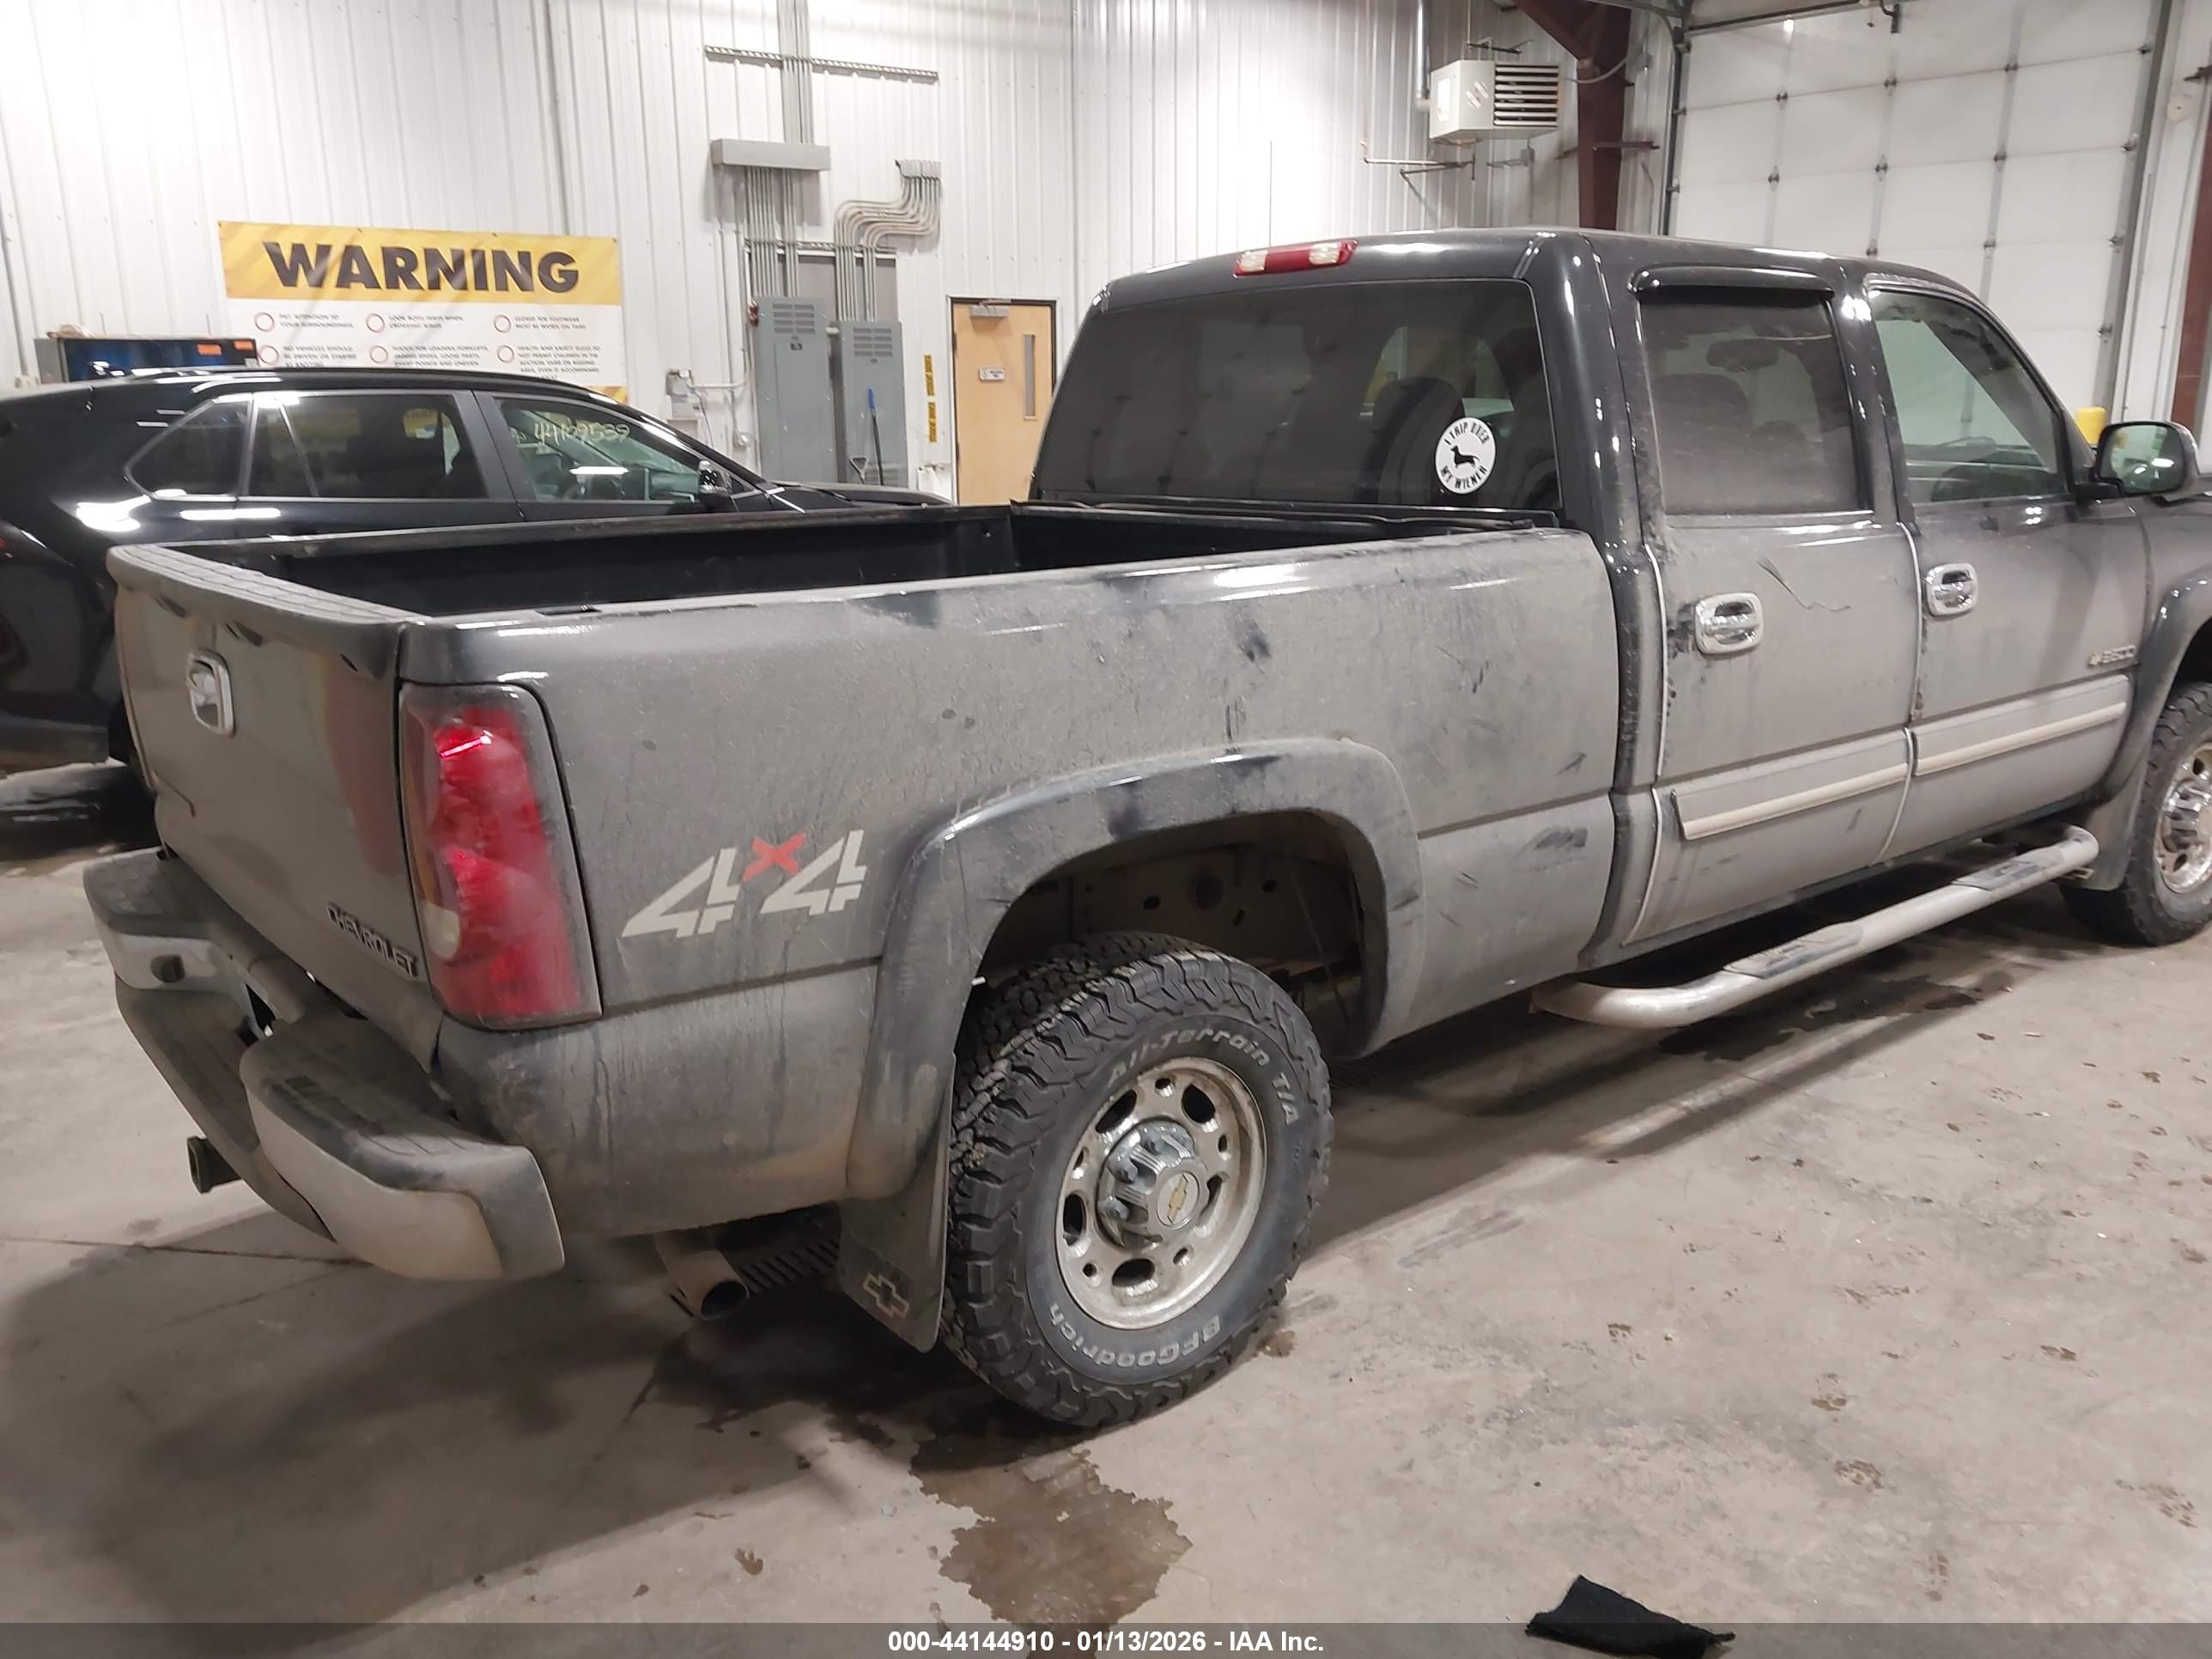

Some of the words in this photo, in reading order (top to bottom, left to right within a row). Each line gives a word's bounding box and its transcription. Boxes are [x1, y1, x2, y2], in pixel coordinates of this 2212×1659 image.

[263, 241, 580, 294] WARNING
[326, 902, 419, 977] CHEVROLET
[1272, 1072, 1299, 1127] T/A
[1049, 1302, 1221, 1368] BFGoodrich
